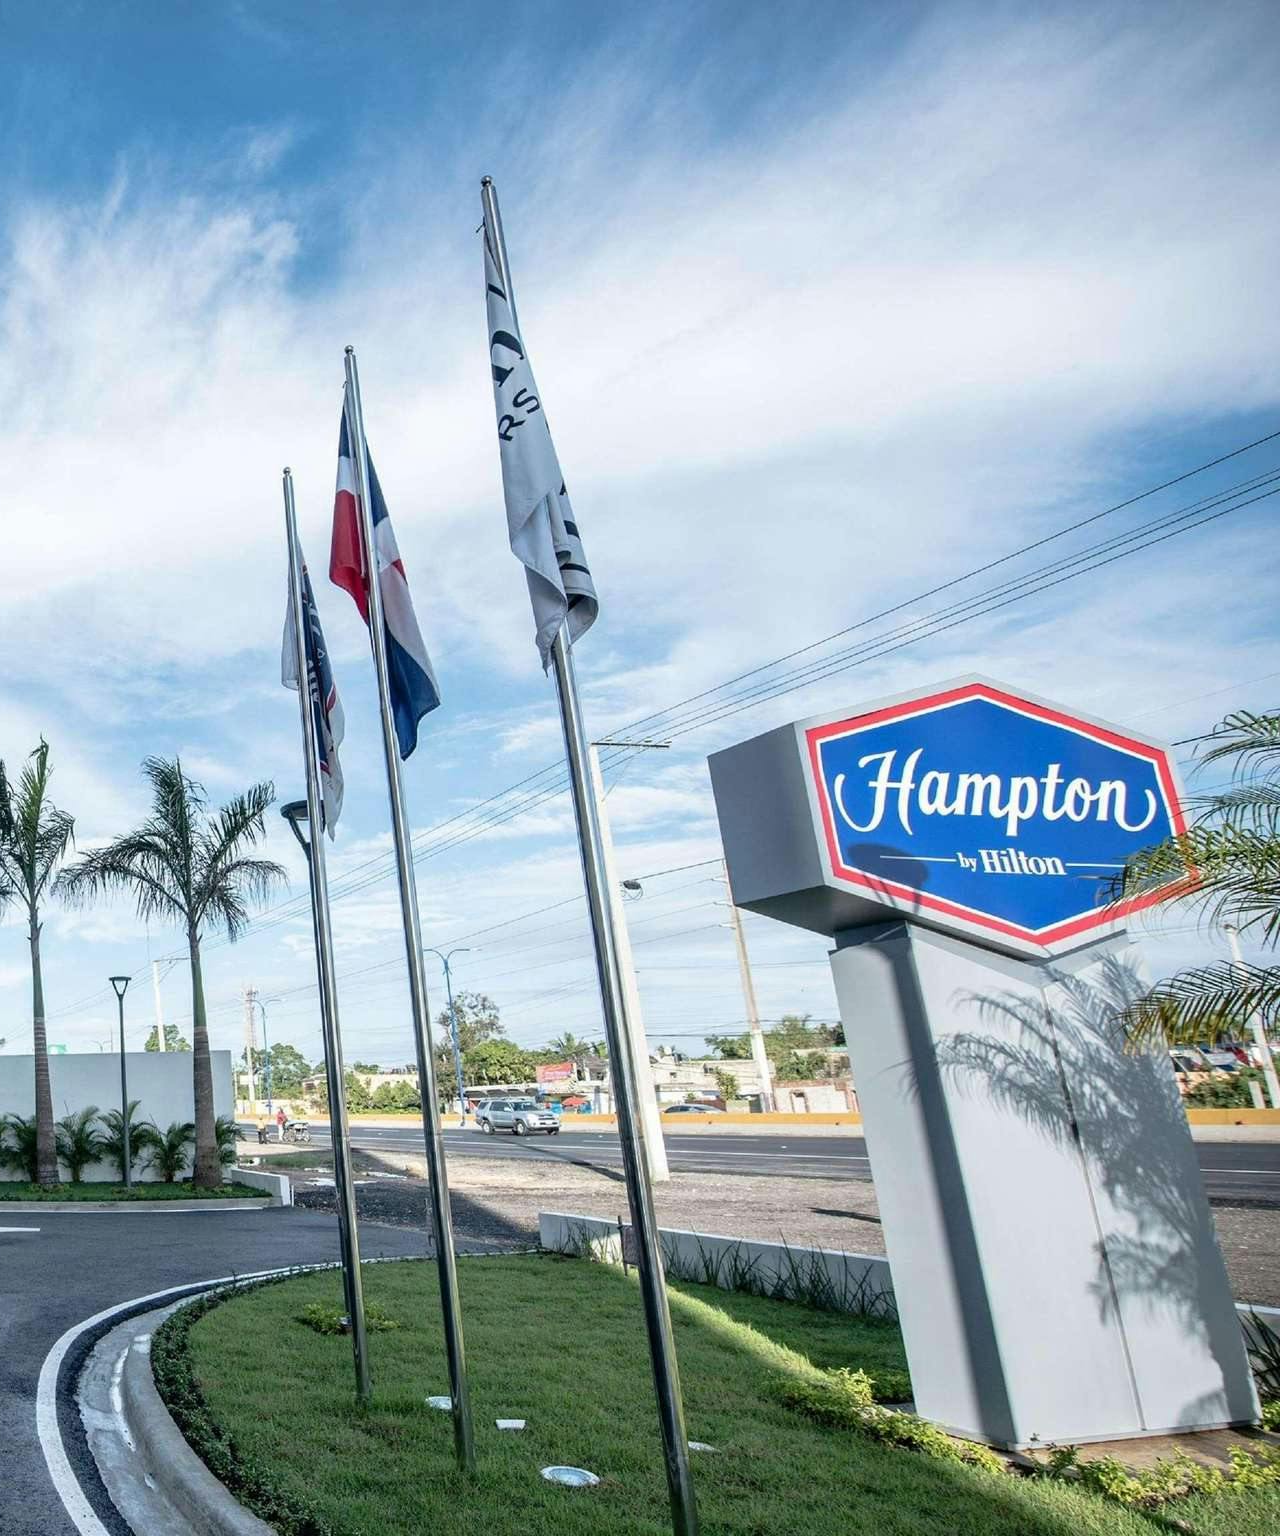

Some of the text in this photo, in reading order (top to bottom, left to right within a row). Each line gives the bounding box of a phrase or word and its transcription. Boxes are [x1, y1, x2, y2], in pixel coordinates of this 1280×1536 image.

[834, 748, 1158, 836] Hampton
[956, 848, 1067, 876] by Hilton
